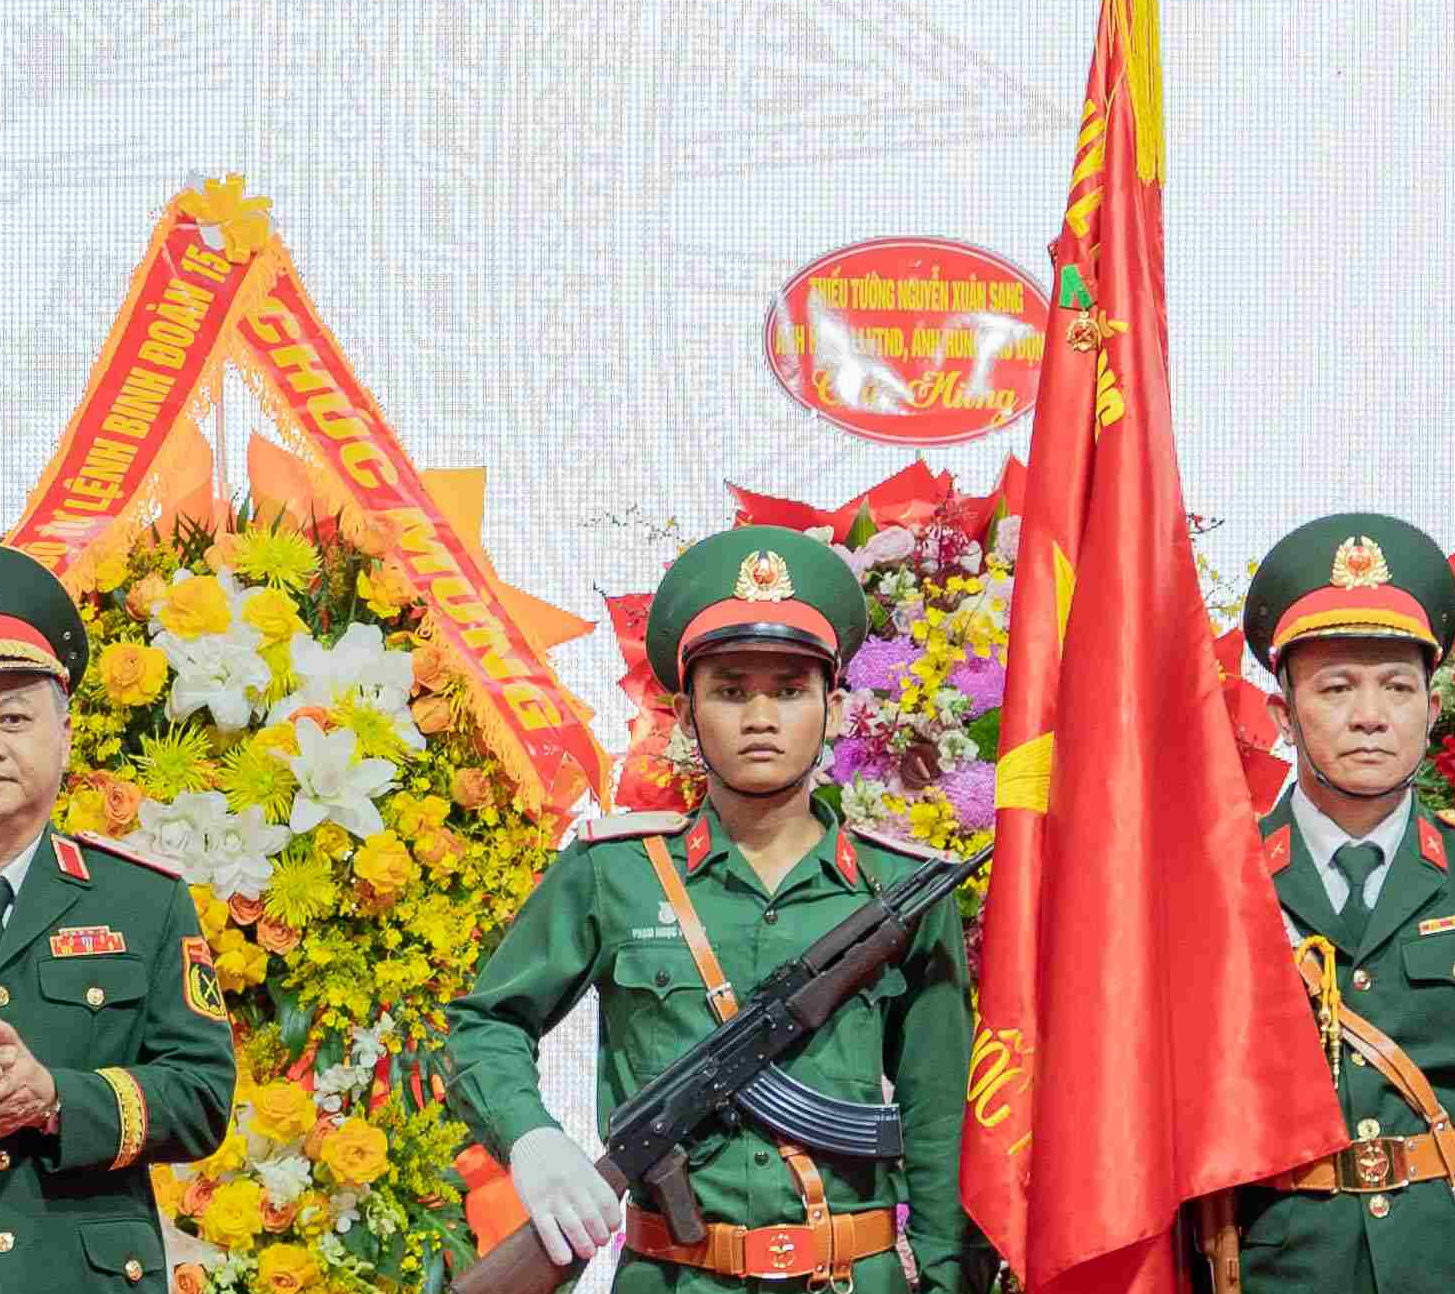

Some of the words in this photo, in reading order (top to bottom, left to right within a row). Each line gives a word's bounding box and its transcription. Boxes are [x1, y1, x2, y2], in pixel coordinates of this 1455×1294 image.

[180, 243, 233, 284] 15
[136, 277, 216, 372] ĐOÀN
[100, 365, 178, 440] BINH
[62, 435, 140, 513] LỆNH
[246, 295, 400, 490] CHÚC
[386, 507, 563, 732] MỪNG
